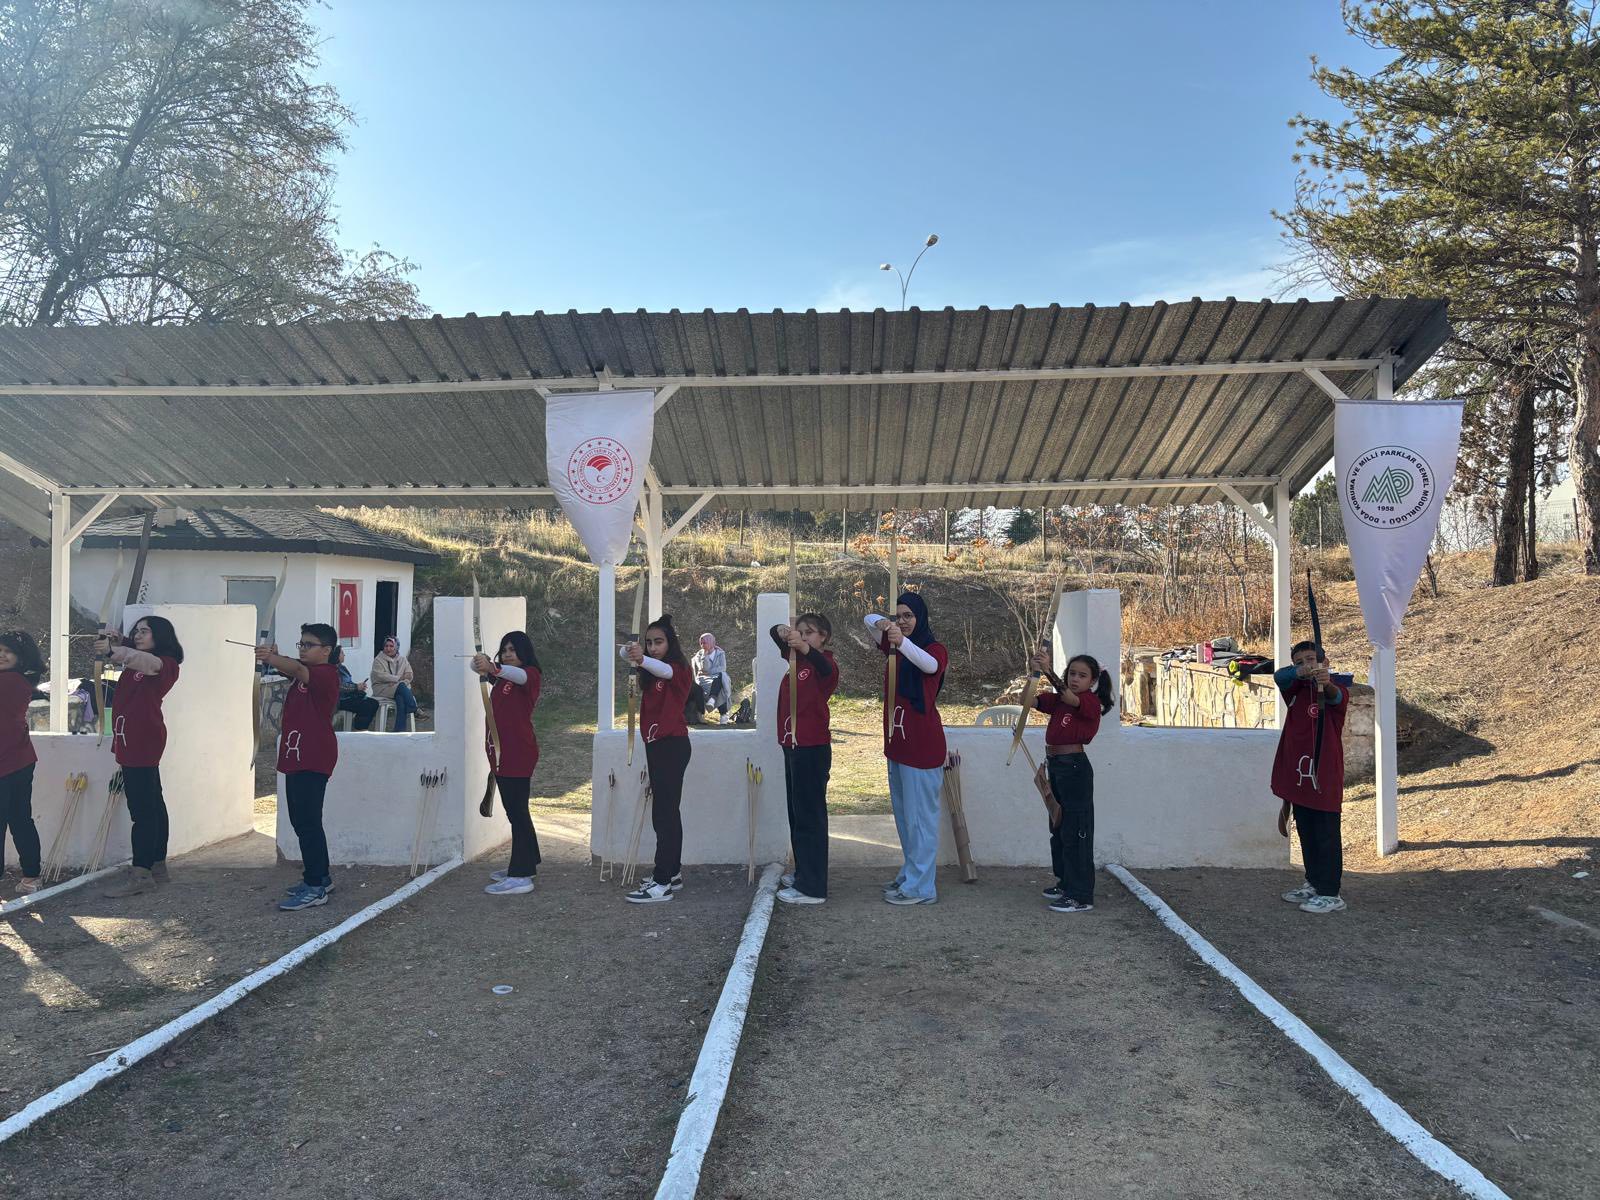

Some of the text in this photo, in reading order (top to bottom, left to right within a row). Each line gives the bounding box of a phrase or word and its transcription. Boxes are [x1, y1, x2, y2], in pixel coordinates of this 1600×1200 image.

[1359, 451, 1379, 467] MİLLİ
[1380, 450, 1417, 464] PARKLAR
[1352, 467, 1360, 477] VE
[1415, 462, 1430, 488] GENEL
[1349, 479, 1361, 511] KORUMA
